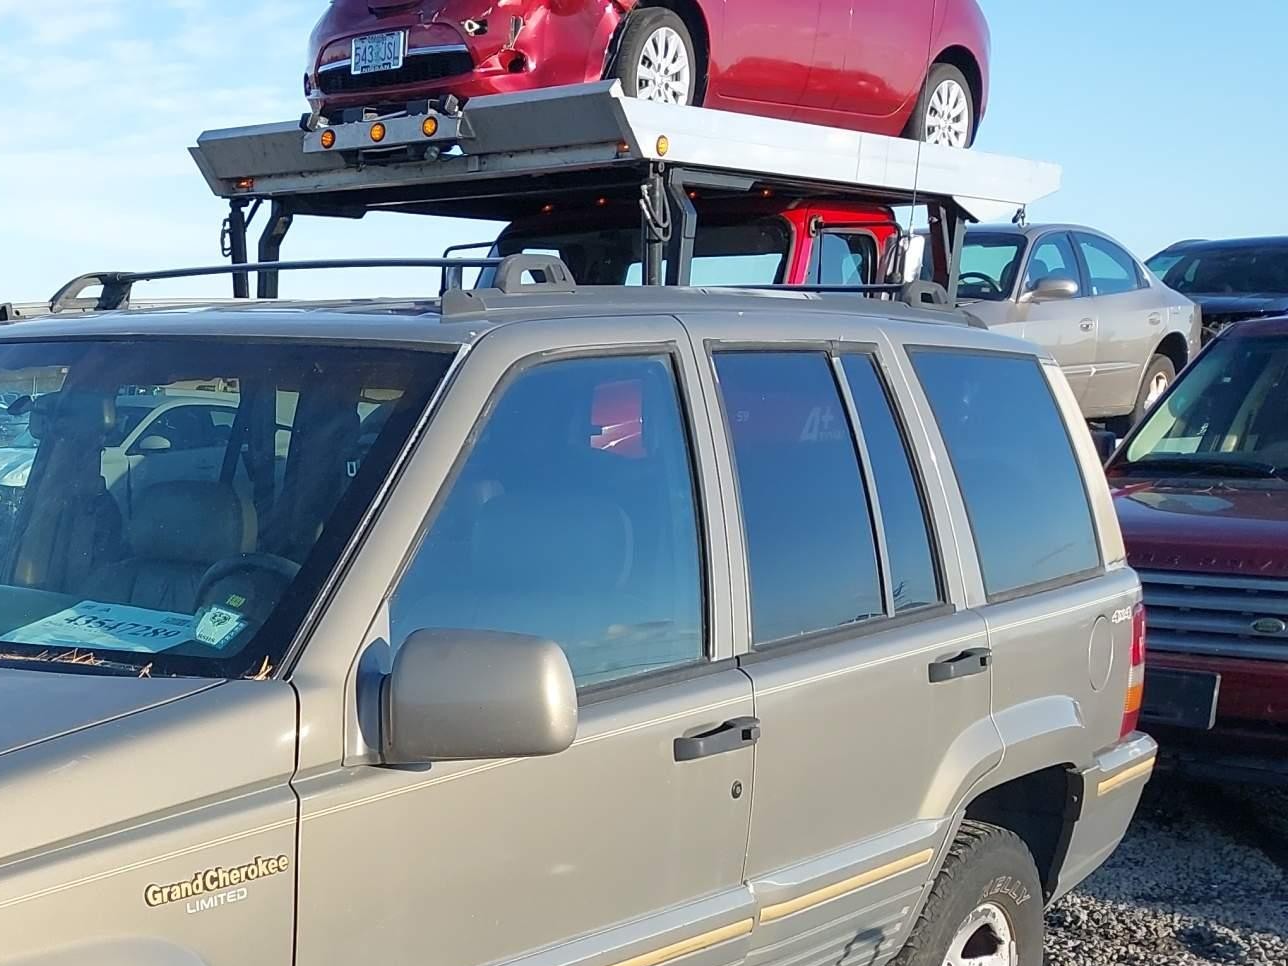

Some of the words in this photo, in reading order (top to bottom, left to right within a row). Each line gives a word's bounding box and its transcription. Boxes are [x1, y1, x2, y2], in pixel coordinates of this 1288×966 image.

[354, 42, 374, 66] 543
[64, 614, 181, 638] 43547289
[145, 871, 203, 907] Grand
[204, 855, 289, 891] Cherokee
[186, 887, 248, 914] LIMITED
